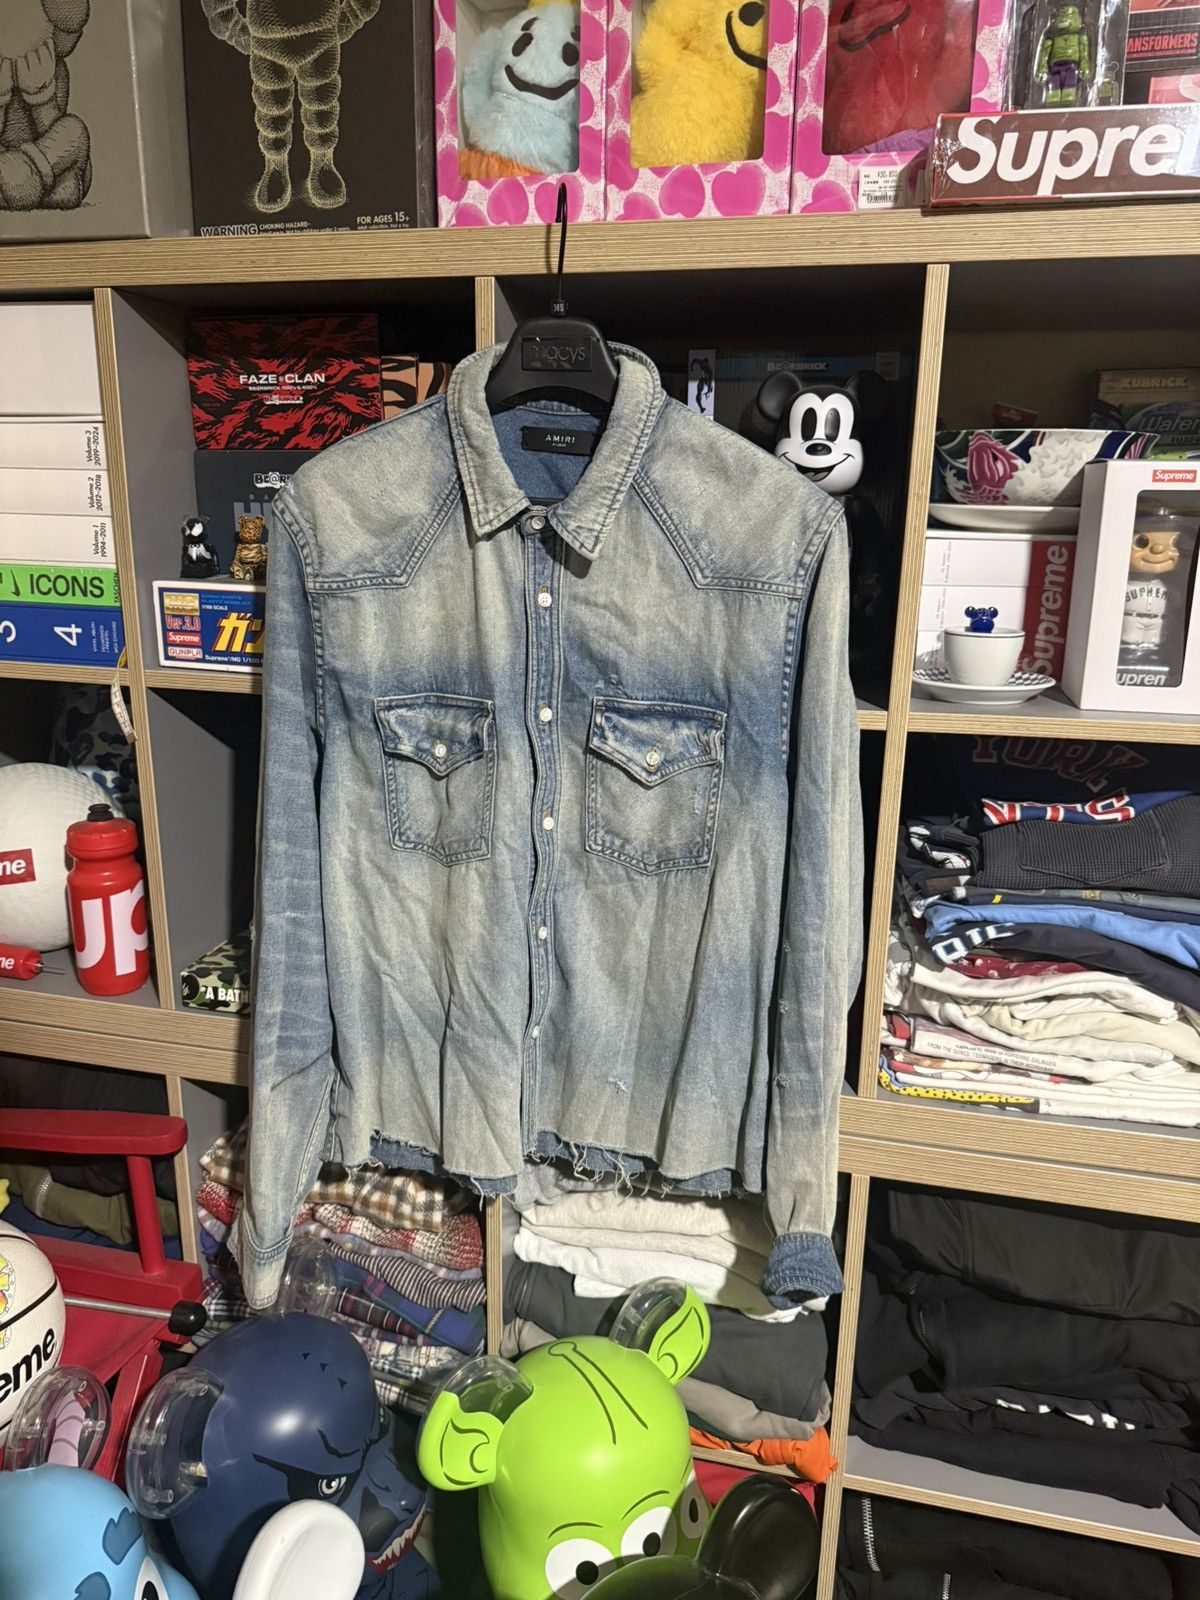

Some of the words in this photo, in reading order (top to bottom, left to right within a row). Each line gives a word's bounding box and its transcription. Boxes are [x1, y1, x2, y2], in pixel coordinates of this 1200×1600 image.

[357, 216, 371, 224] FOR
[373, 215, 392, 223] AGES
[394, 211, 409, 222] 15+
[200, 223, 258, 236] WARNING
[240, 374, 278, 384] FAZE
[285, 373, 325, 383] CLAN
[85, 438, 93, 462] Volume
[93, 426, 101, 466] 2019-2024
[545, 434, 576, 443] AMIRI
[1153, 469, 1195, 481] Supreme
[87, 483, 95, 508] Volume
[92, 529, 100, 555] Volume
[29, 573, 104, 598] ICONS
[1022, 544, 1070, 675] Supreme
[53, 623, 83, 646] 4
[168, 632, 200, 643] Supreme
